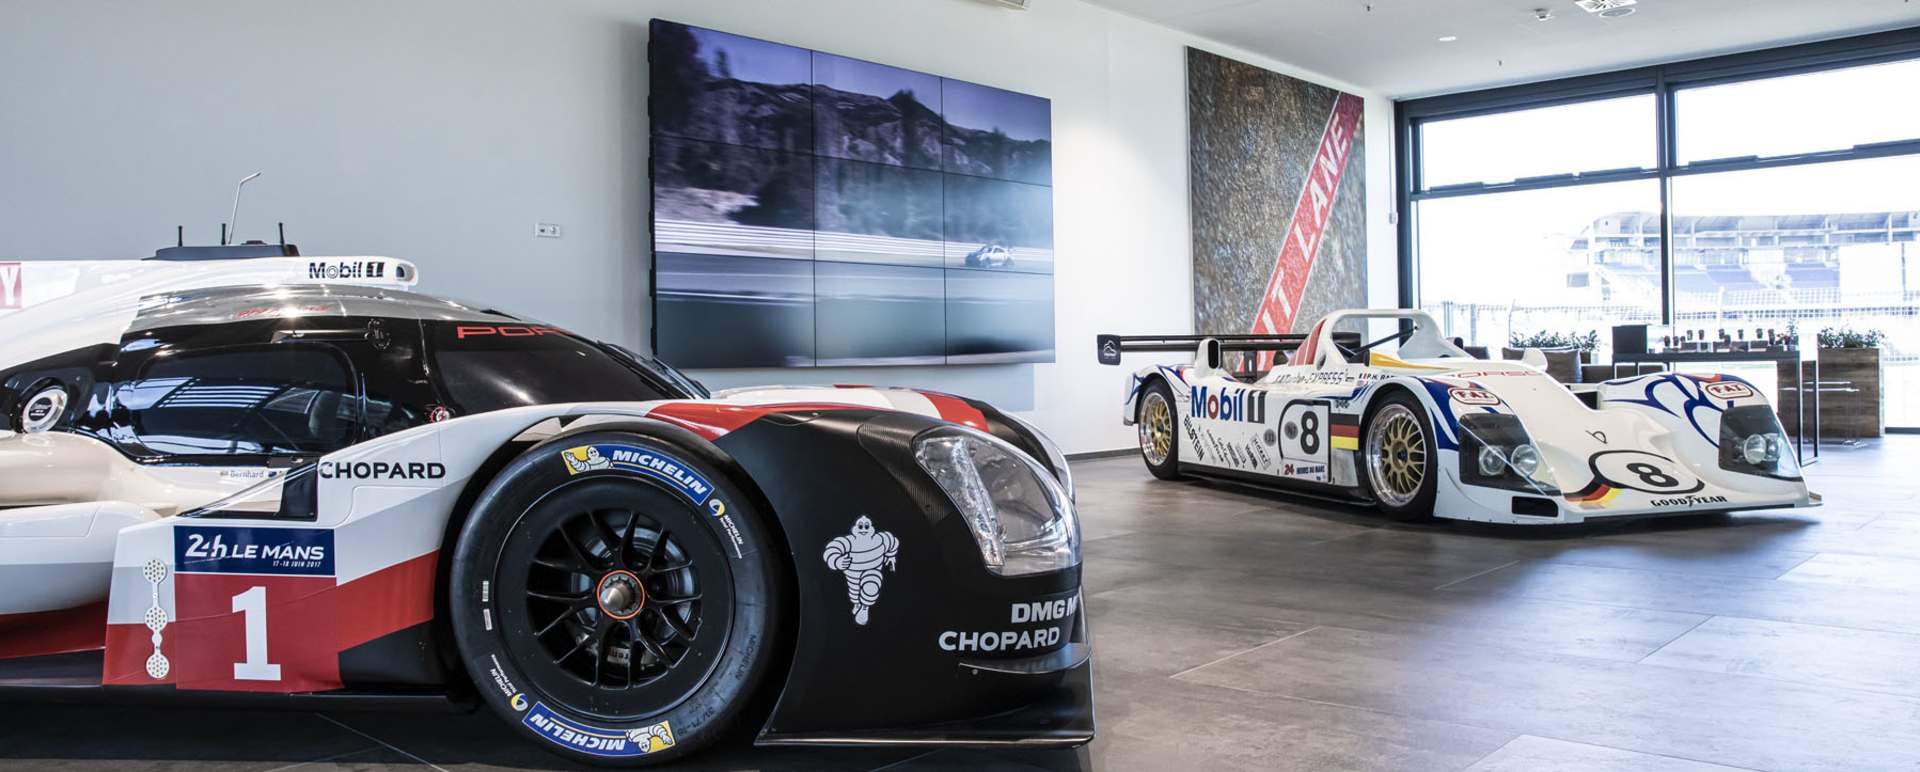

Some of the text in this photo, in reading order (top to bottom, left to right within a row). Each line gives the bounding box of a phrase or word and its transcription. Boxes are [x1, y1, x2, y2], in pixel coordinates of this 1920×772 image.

[1294, 115, 1348, 262] LANE
[309, 261, 384, 278] Mobil 1
[1191, 385, 1268, 424] Mobil 1
[1300, 410, 1320, 455] 8
[319, 462, 446, 479] CHOPARD
[613, 449, 708, 495] MICHELIN
[1284, 463, 1295, 475] 24
[1626, 462, 1680, 488] 8
[722, 514, 744, 545] MICHELIN
[185, 533, 325, 561] 24h LE MANS
[1011, 599, 1065, 624] DMG
[232, 585, 281, 681] 1
[938, 626, 1061, 652] CHOPARD
[490, 668, 512, 697] MICHELIN
[529, 712, 626, 751] MICHELIN
